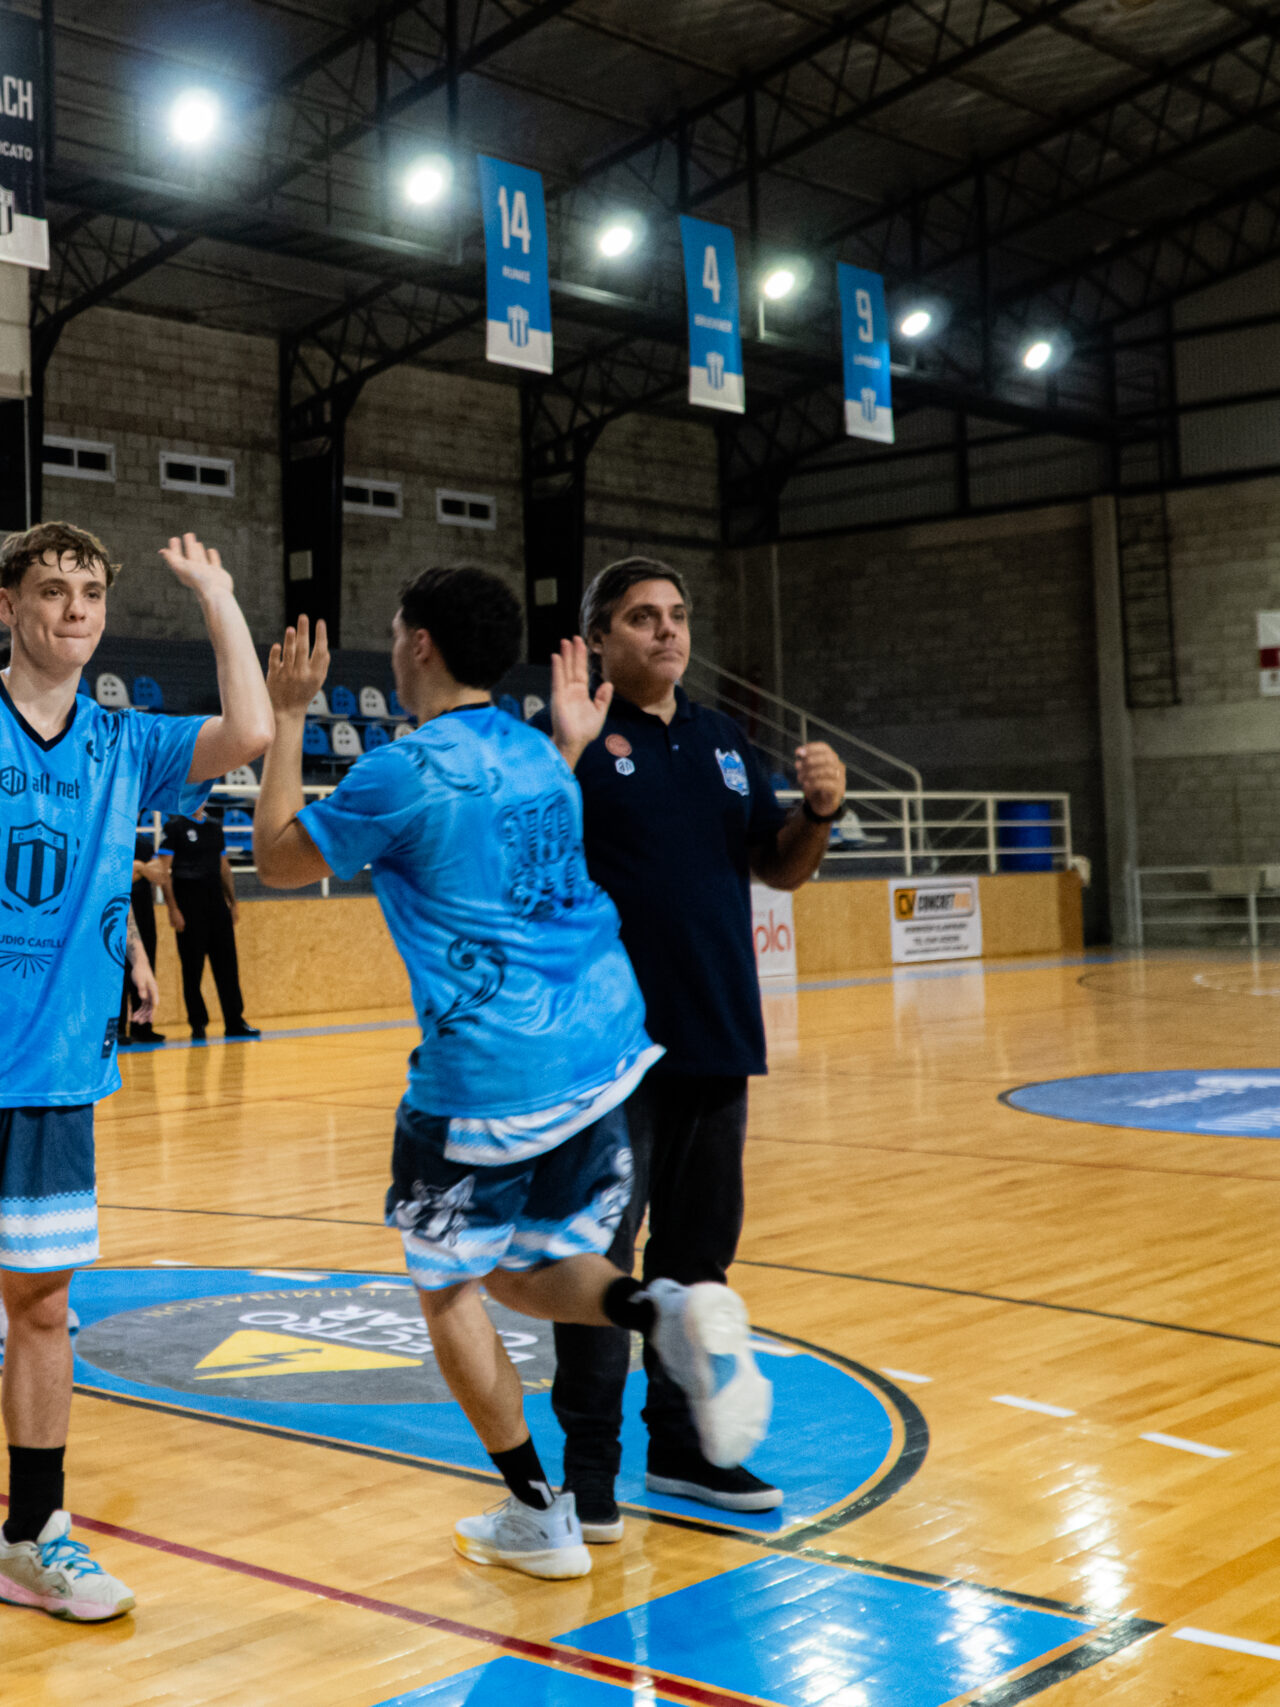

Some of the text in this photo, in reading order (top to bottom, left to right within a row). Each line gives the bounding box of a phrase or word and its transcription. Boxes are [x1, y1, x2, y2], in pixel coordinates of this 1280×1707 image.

[498, 185, 531, 254] 14
[703, 245, 721, 304] 4
[855, 288, 873, 343] 9
[32, 772, 50, 794] all
[56, 778, 80, 800] net
